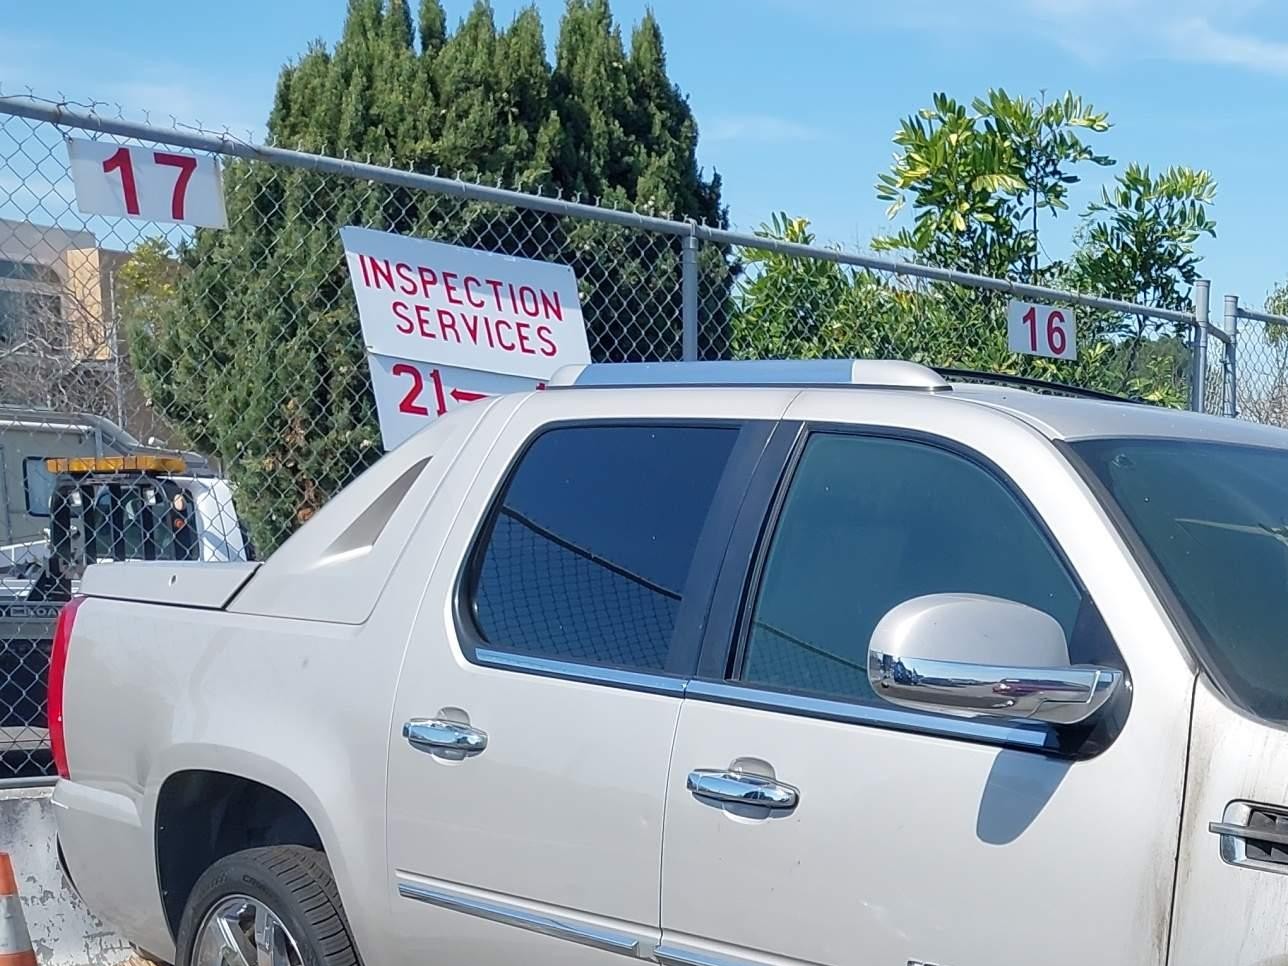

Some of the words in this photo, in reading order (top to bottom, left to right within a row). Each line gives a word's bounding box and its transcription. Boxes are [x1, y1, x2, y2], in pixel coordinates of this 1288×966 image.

[102, 147, 198, 221] 17
[357, 254, 564, 323] INSPECTION
[391, 300, 558, 358] SERVICES
[1022, 306, 1067, 356] 16
[391, 363, 448, 418] 21
